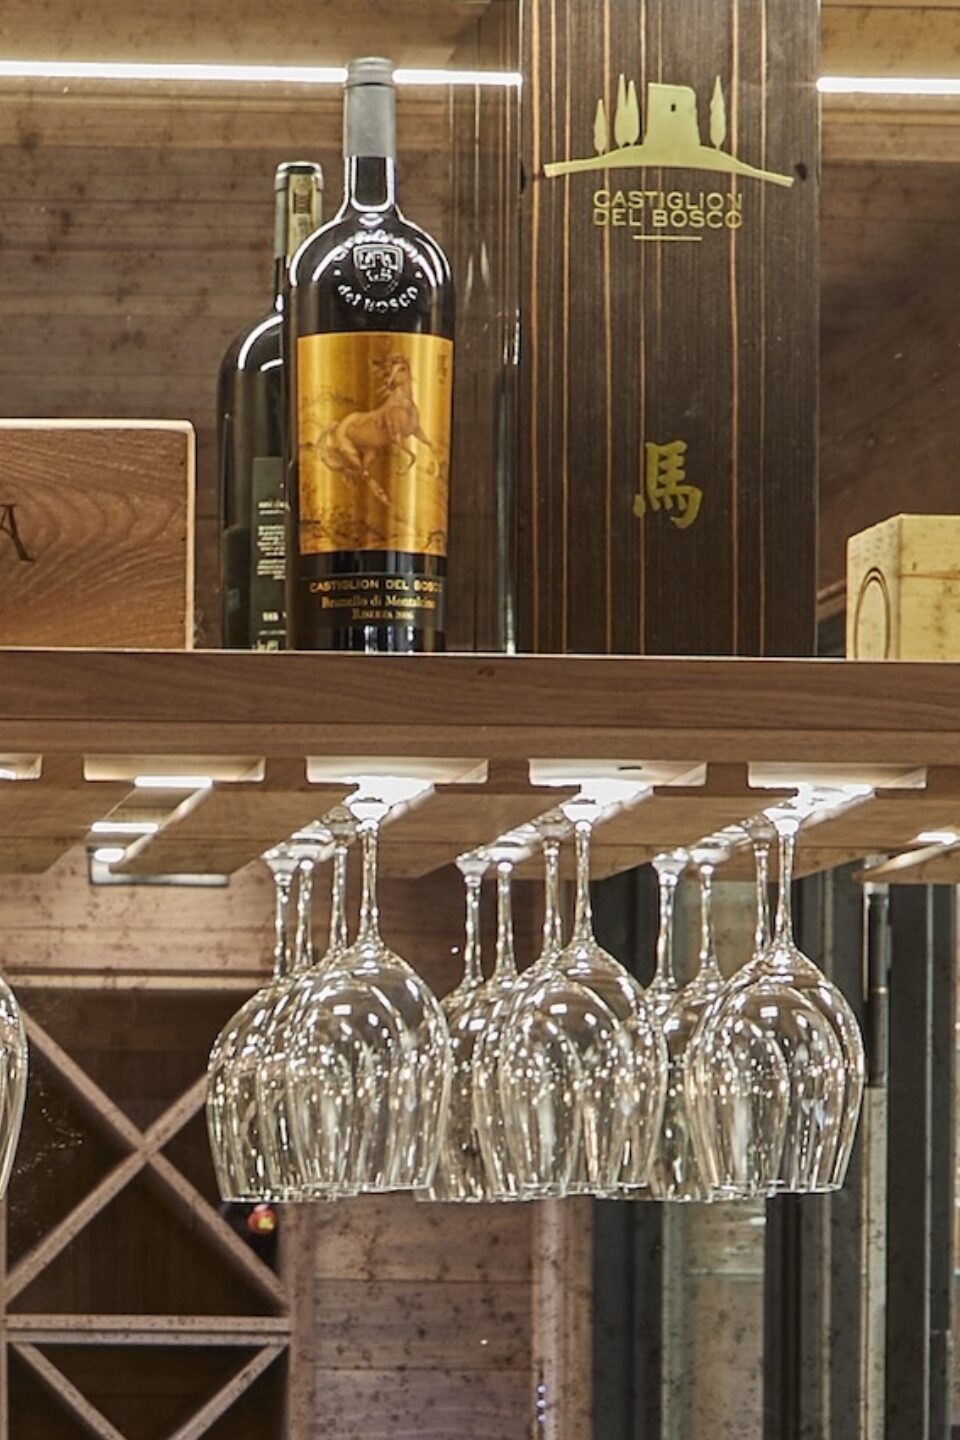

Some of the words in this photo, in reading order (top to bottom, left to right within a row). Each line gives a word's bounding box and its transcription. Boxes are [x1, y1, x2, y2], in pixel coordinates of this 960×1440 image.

[593, 189, 743, 210] CASTIGLION
[592, 208, 642, 227] DEL
[651, 209, 743, 229] BOSCO
[632, 439, 704, 530] 馬
[384, 578, 410, 592] DEL
